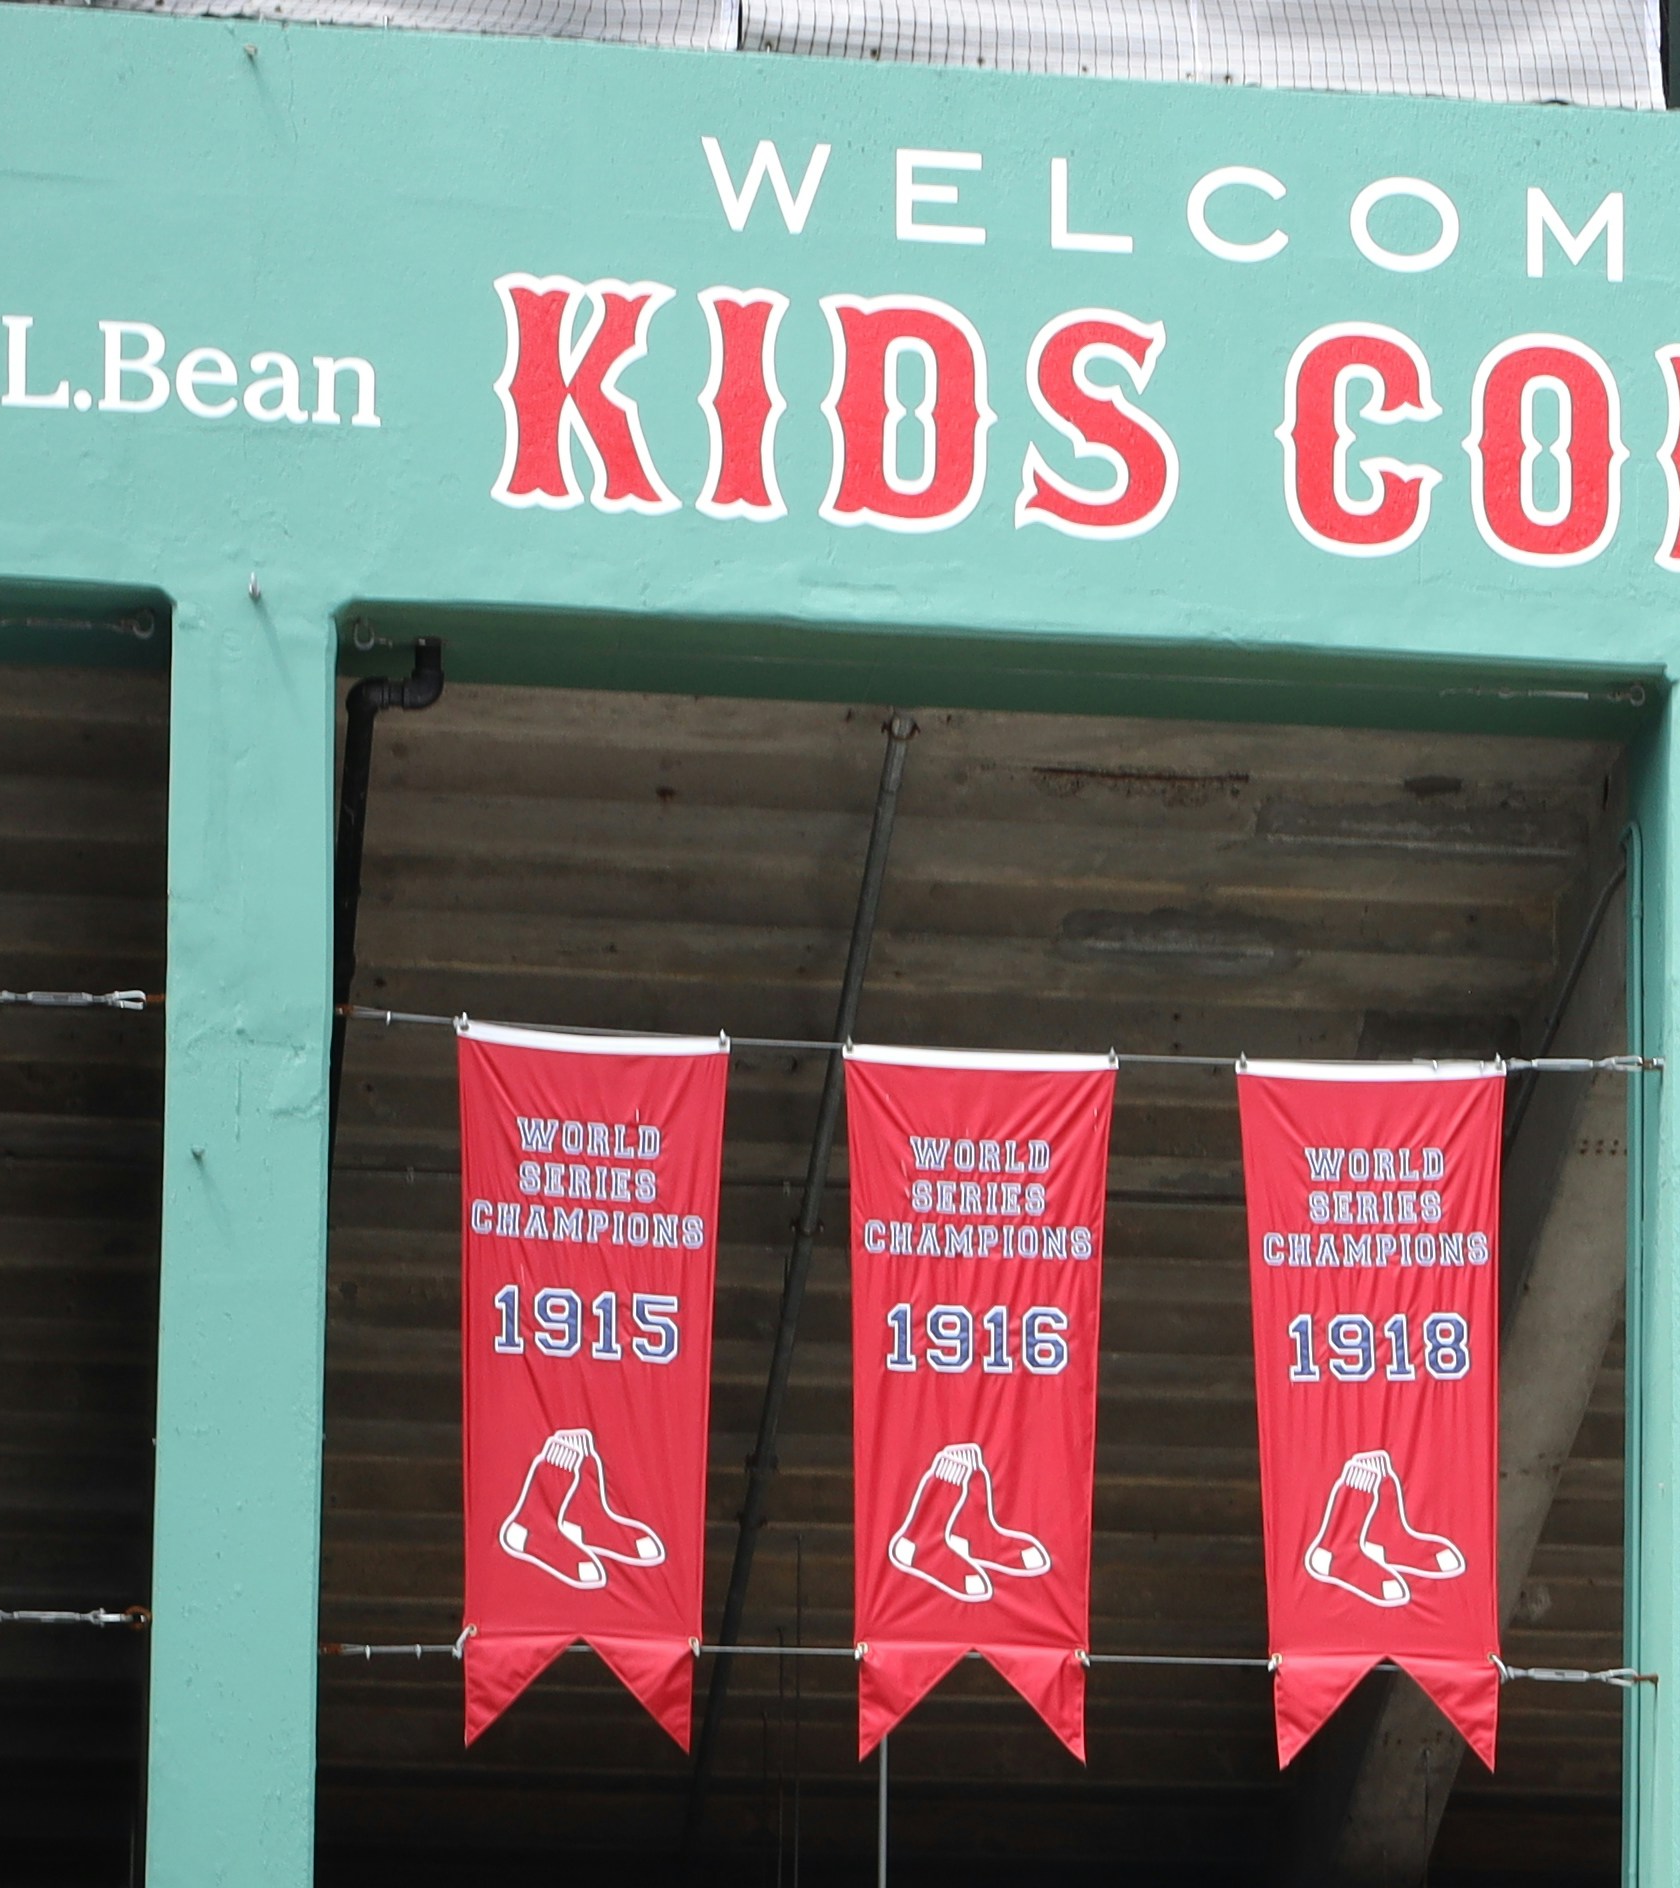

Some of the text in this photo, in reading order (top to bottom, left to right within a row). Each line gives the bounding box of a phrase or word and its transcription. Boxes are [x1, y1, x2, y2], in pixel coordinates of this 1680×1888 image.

[491, 270, 1181, 542] KIDS
[517, 1116, 661, 1159] WORLD
[909, 1136, 1051, 1173] WORLD
[519, 1162, 657, 1203] SERIES
[1304, 1147, 1444, 1182] WORLD
[912, 1180, 1046, 1215] SERIES
[1309, 1191, 1442, 1225] SERIES
[471, 1200, 705, 1250] CHAMPIONS
[864, 1220, 1092, 1260] CHAMPIONS
[1263, 1232, 1489, 1267] CHAMPIONS
[494, 1284, 679, 1365] 1915
[886, 1302, 1068, 1374] 1916
[1287, 1313, 1471, 1382] 1918
